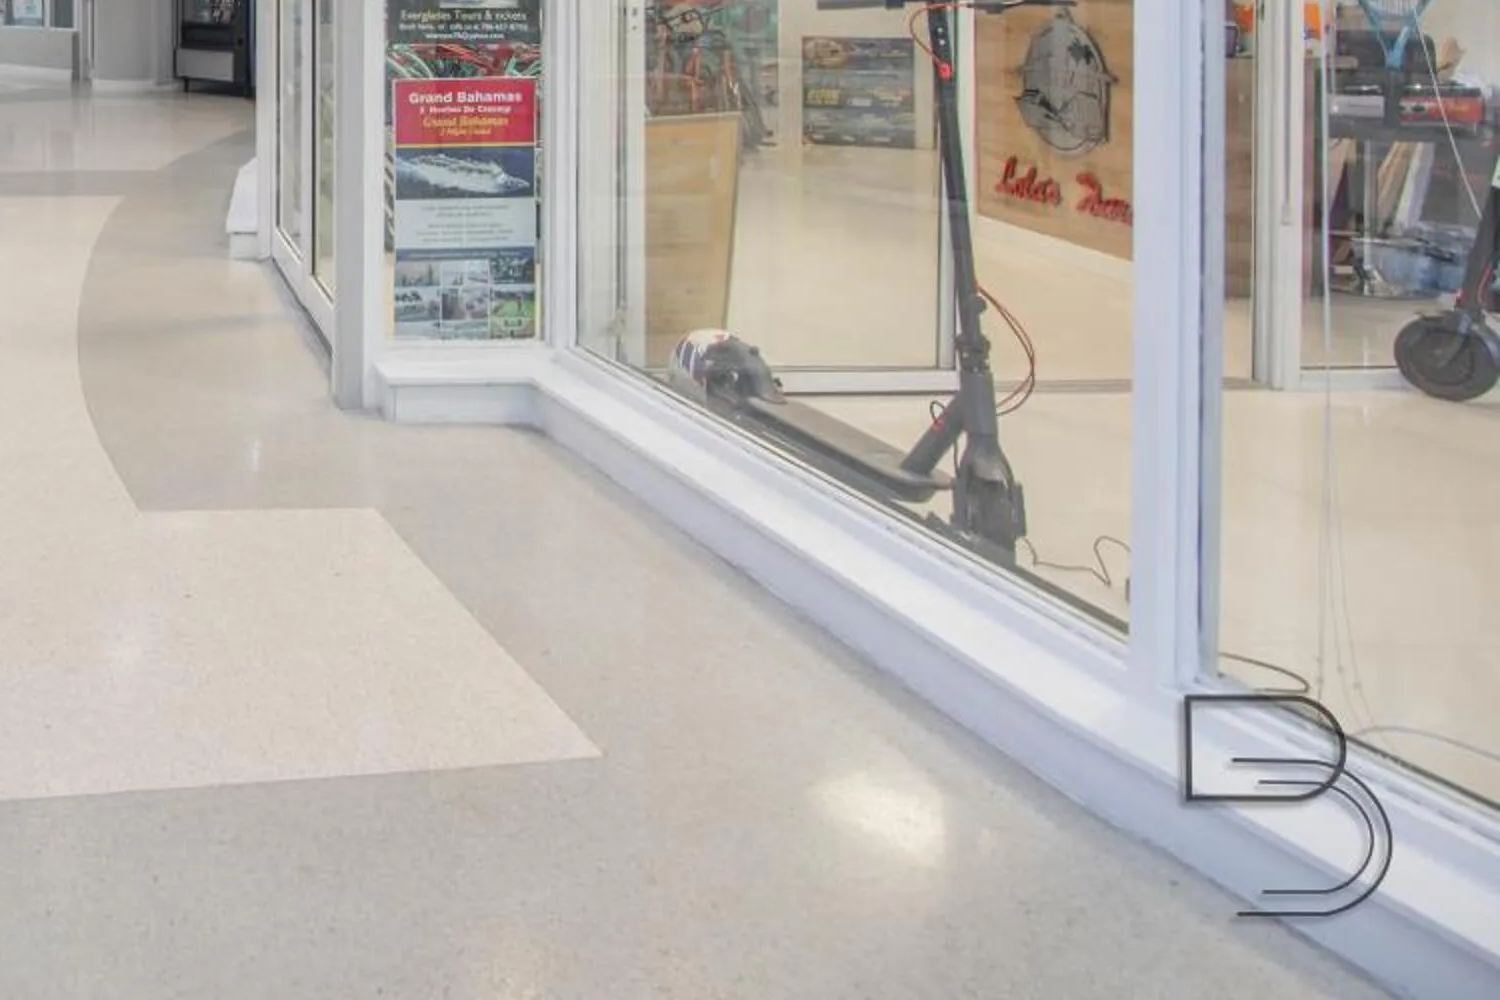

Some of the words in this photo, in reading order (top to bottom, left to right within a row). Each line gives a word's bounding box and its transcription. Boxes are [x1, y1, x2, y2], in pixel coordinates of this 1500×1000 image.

[408, 91, 453, 104] Grand
[456, 90, 523, 103] Bahamas
[422, 115, 457, 128] Grand
